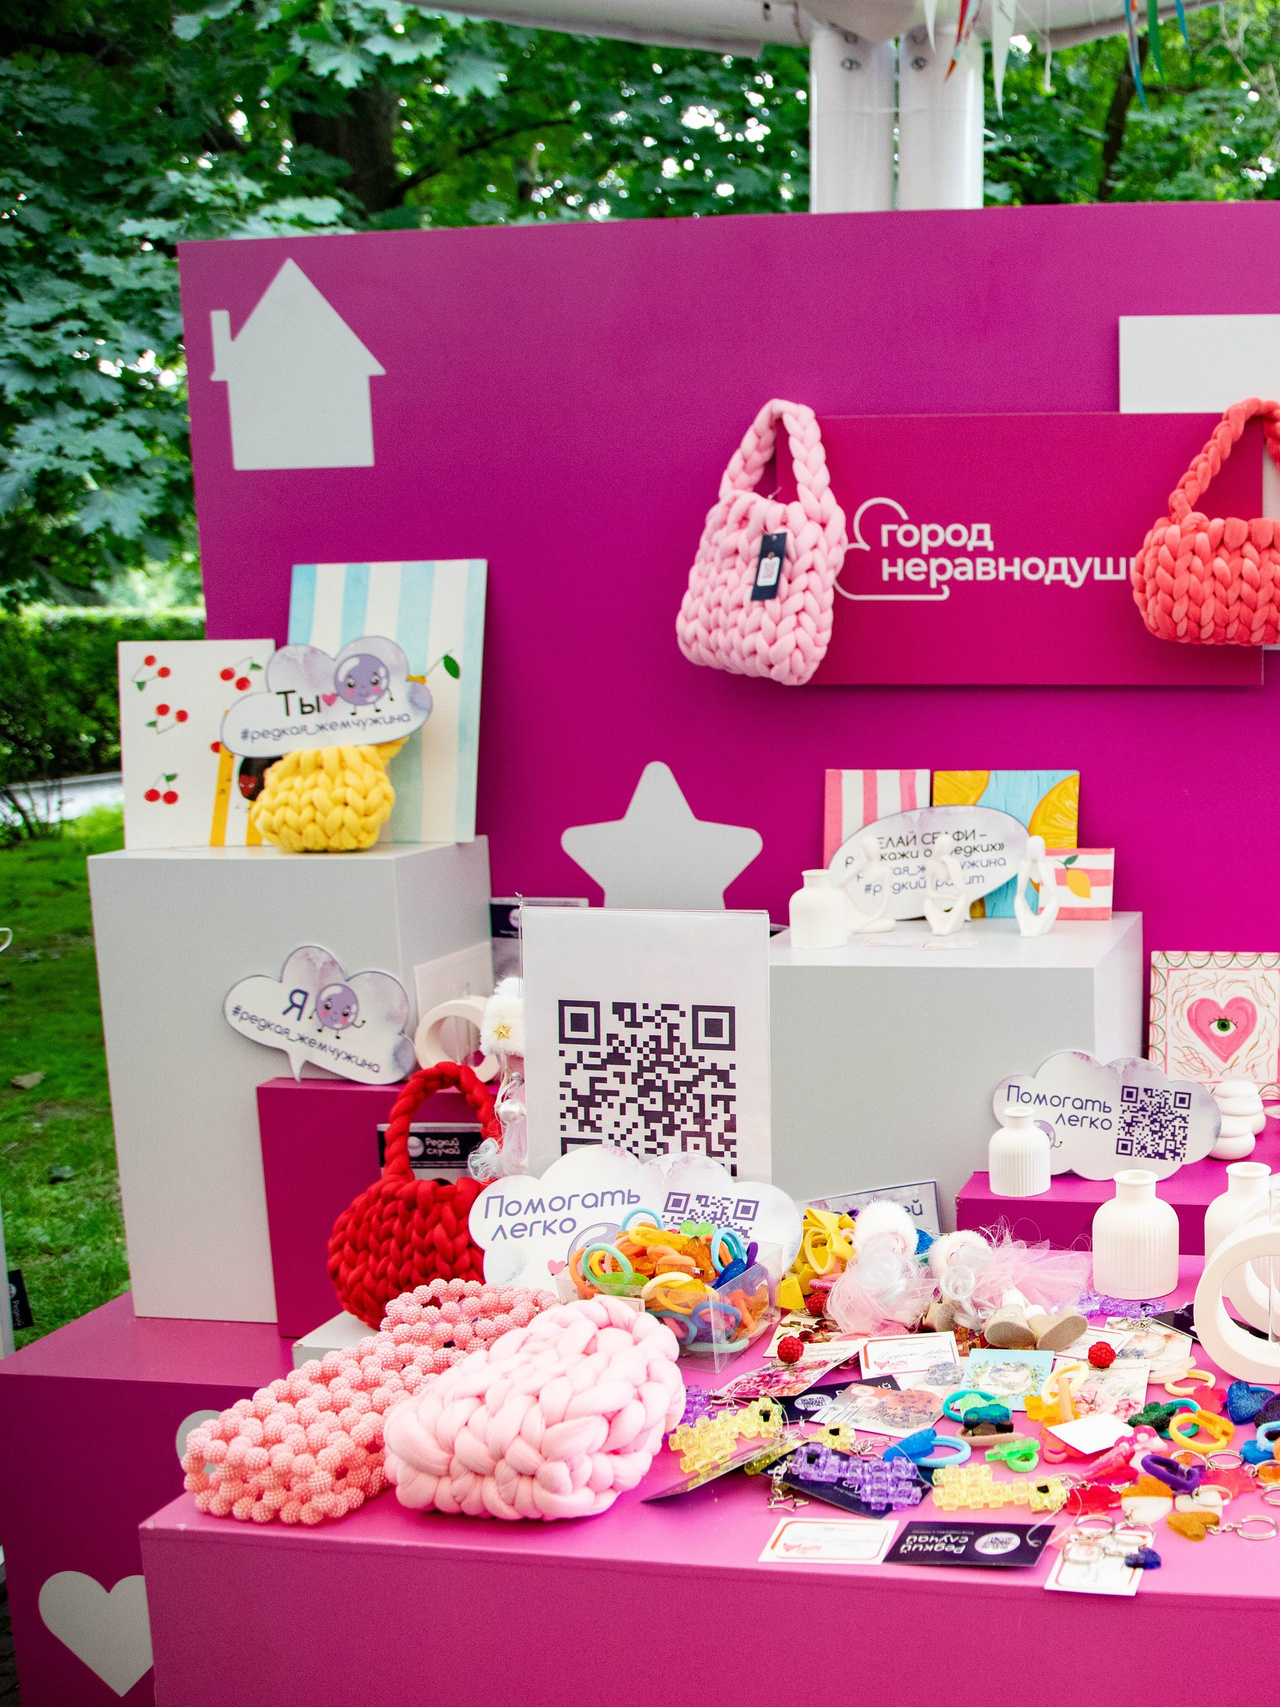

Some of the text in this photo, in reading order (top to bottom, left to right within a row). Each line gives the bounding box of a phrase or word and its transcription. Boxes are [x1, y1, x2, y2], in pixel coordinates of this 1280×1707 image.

[881, 523, 994, 555] город
[882, 557, 1137, 589] неравнодуш
[276, 690, 321, 717] Ты
[241, 713, 411, 743] #редкая_жемчужина
[874, 831, 917, 850] ЕЛАЙ
[921, 829, 976, 846] СЕФИ
[844, 850, 919, 868] ркажи
[924, 849, 932, 858] о
[282, 988, 309, 1021] Я
[231, 1004, 381, 1074] #редкая_жемчужина
[1006, 1084, 1112, 1114] Помогать
[1054, 1113, 1113, 1131] легко
[483, 1189, 641, 1219] Помогать
[491, 1214, 578, 1242] легко
[899, 1543, 967, 1555] Редкий
[905, 1533, 970, 1546] случай
